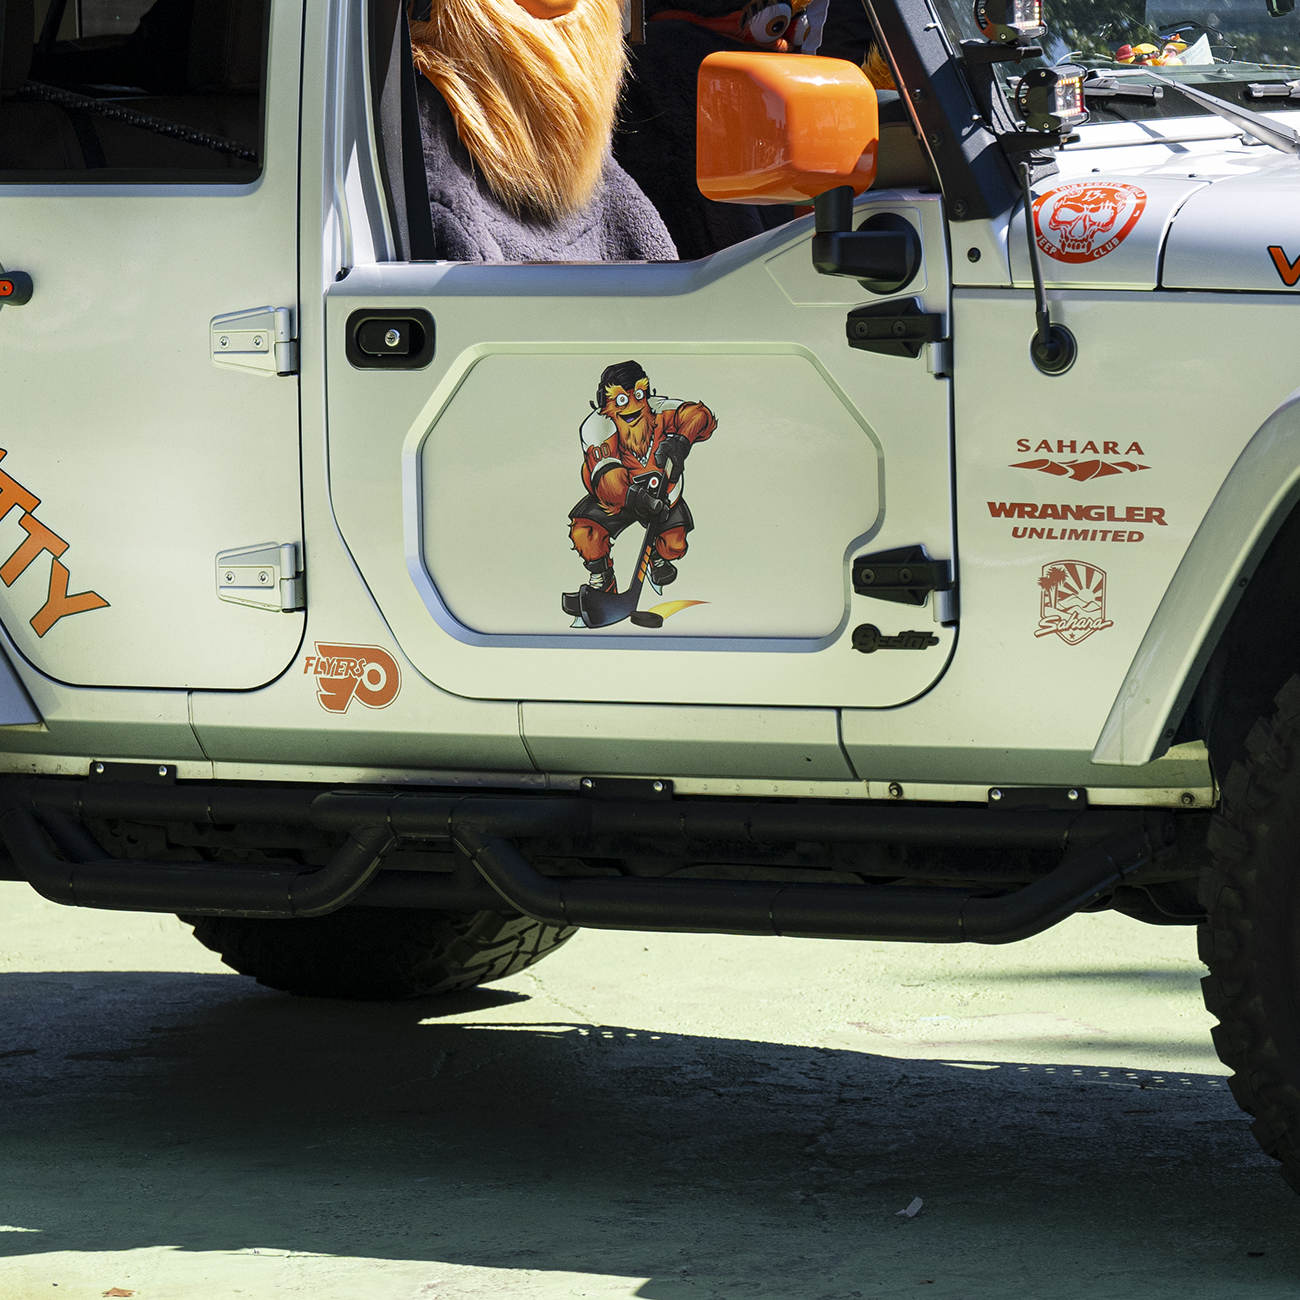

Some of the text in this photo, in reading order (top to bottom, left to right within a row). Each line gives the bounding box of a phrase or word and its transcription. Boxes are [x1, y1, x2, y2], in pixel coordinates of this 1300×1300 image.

[1035, 235, 1120, 258] JEEP CLUB
[1016, 438, 1145, 456] SAHARA
[987, 501, 1169, 526] WRANGLER
[1011, 526, 1145, 543] UNLIMITED
[1034, 610, 1115, 639] Sahara
[303, 656, 367, 679] FLYERS
